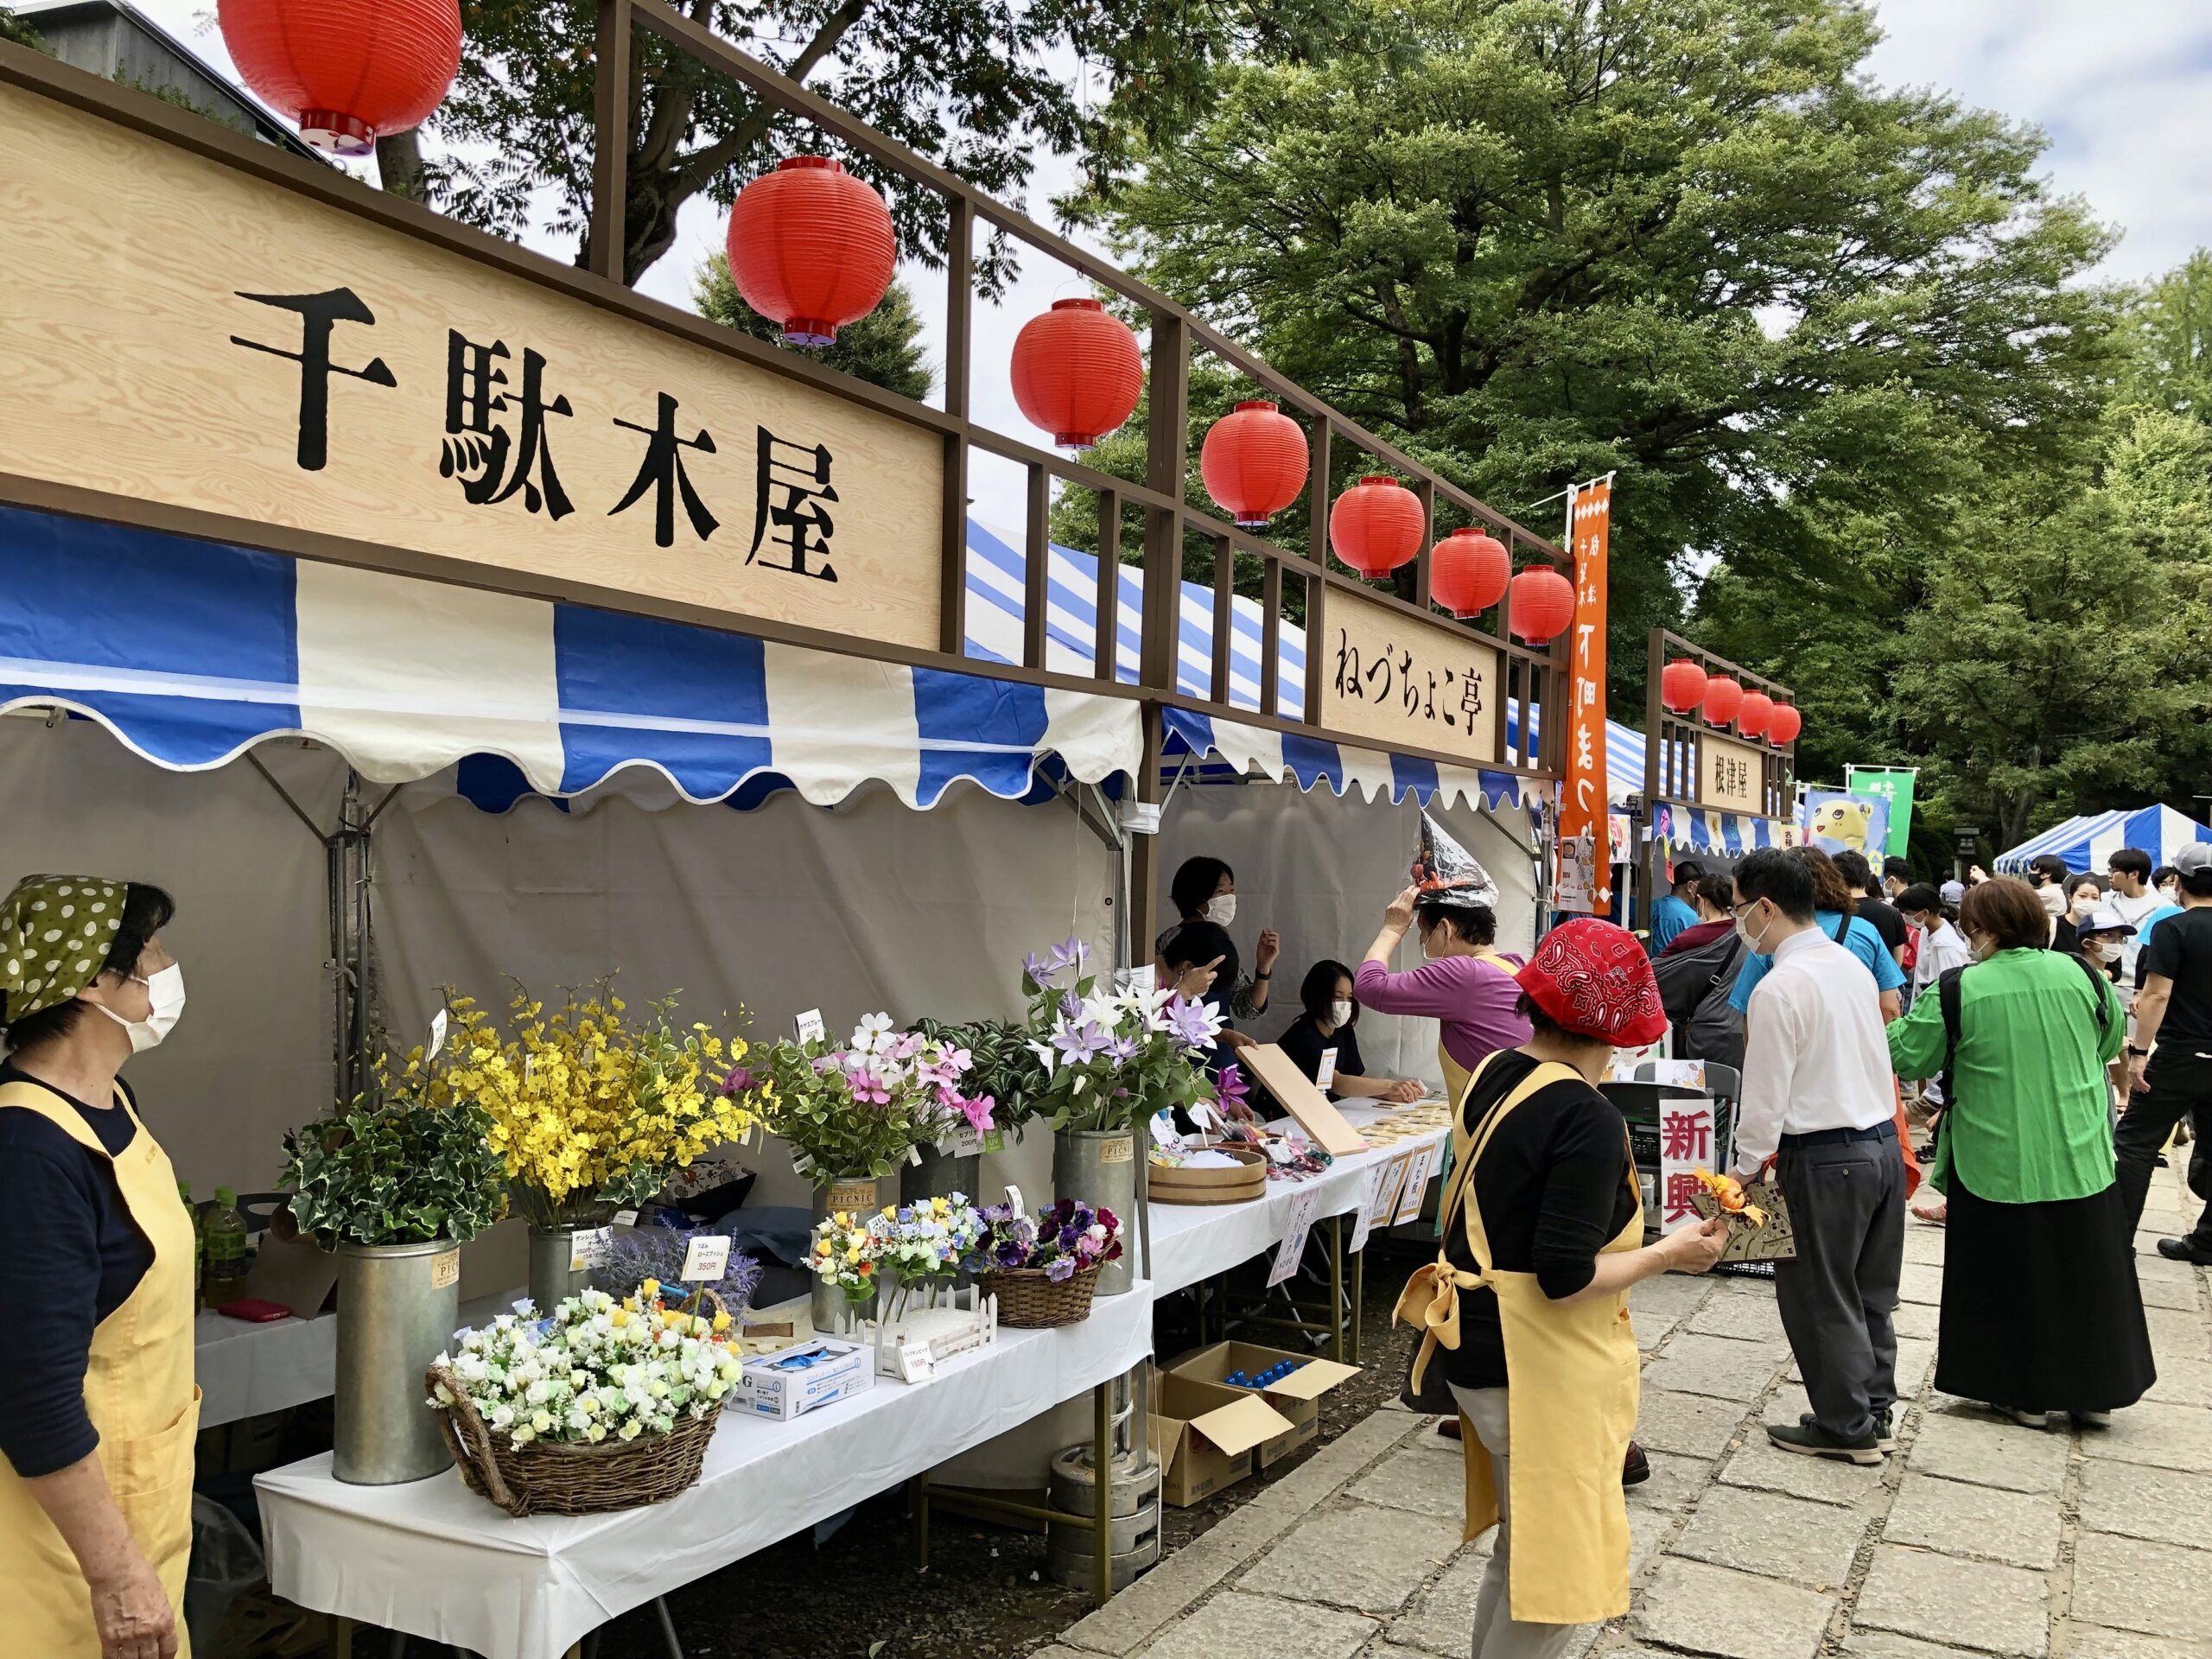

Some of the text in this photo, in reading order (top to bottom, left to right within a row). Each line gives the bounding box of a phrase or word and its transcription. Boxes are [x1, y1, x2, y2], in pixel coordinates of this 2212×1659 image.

[230, 287, 838, 583] 千駄木屋
[1335, 628, 1482, 736] ねづちょこ亭
[1714, 754, 1747, 798] 根津屋
[961, 1138, 977, 1147] 200円
[833, 1193, 872, 1204] PICNIC
[697, 1262, 717, 1271] 350円
